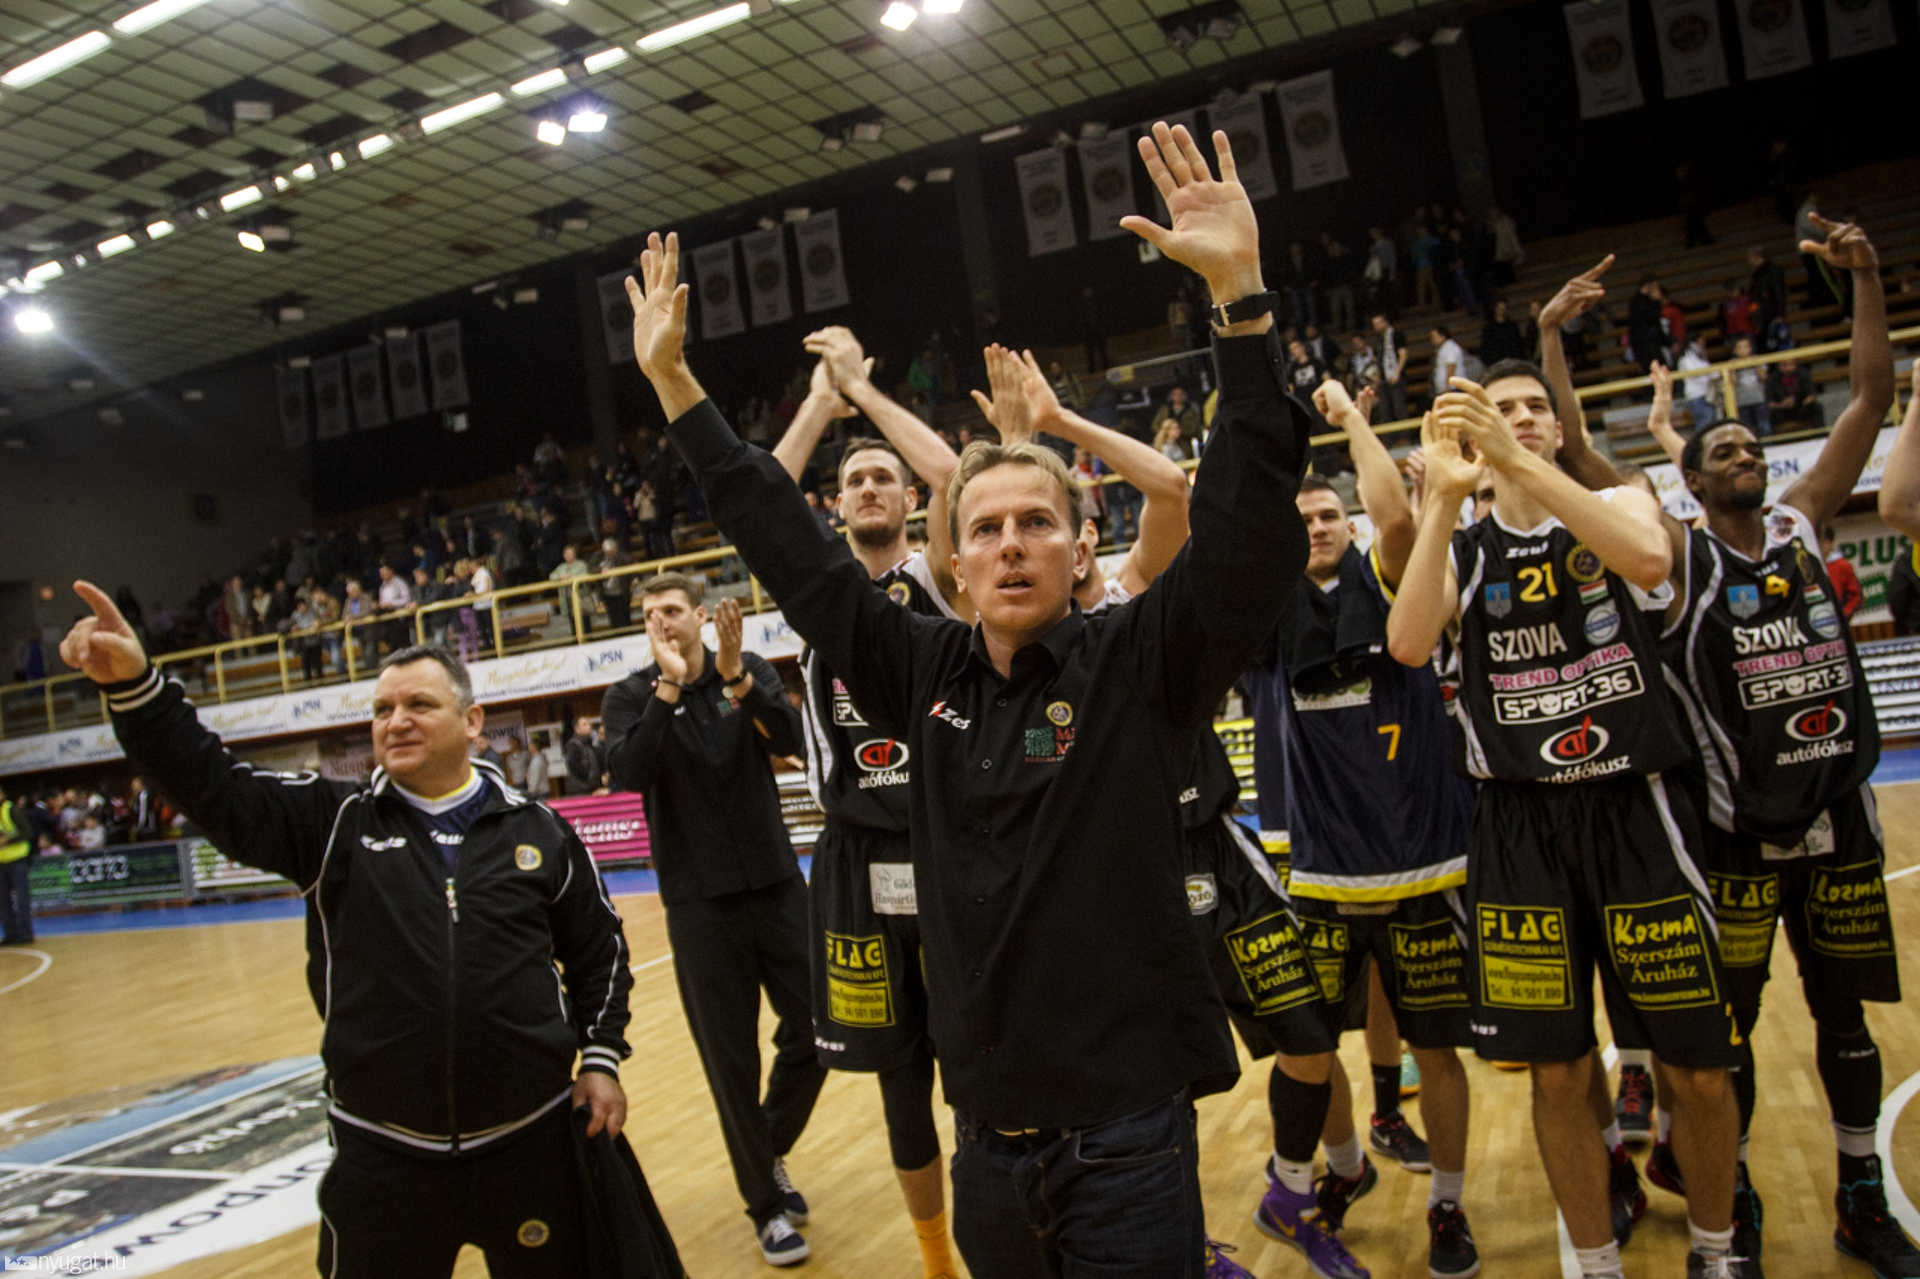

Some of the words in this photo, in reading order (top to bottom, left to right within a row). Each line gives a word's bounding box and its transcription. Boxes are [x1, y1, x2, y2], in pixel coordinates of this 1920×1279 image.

[1517, 562, 1558, 602] 21
[1488, 622, 1568, 662] SZOVA
[1732, 616, 1808, 654] SZOVA
[1489, 667, 1558, 690] TREND
[1733, 651, 1802, 677] TREND
[1503, 671, 1633, 719] SPORT-36
[1751, 665, 1848, 702] SPORT-3
[1378, 724, 1401, 761] 7
[1536, 755, 1631, 785] tófókusz
[1299, 921, 1345, 952] AG
[1482, 911, 1561, 941] FLAG
[1616, 941, 1701, 964] Szerszám
[1631, 960, 1698, 984] Áruház
